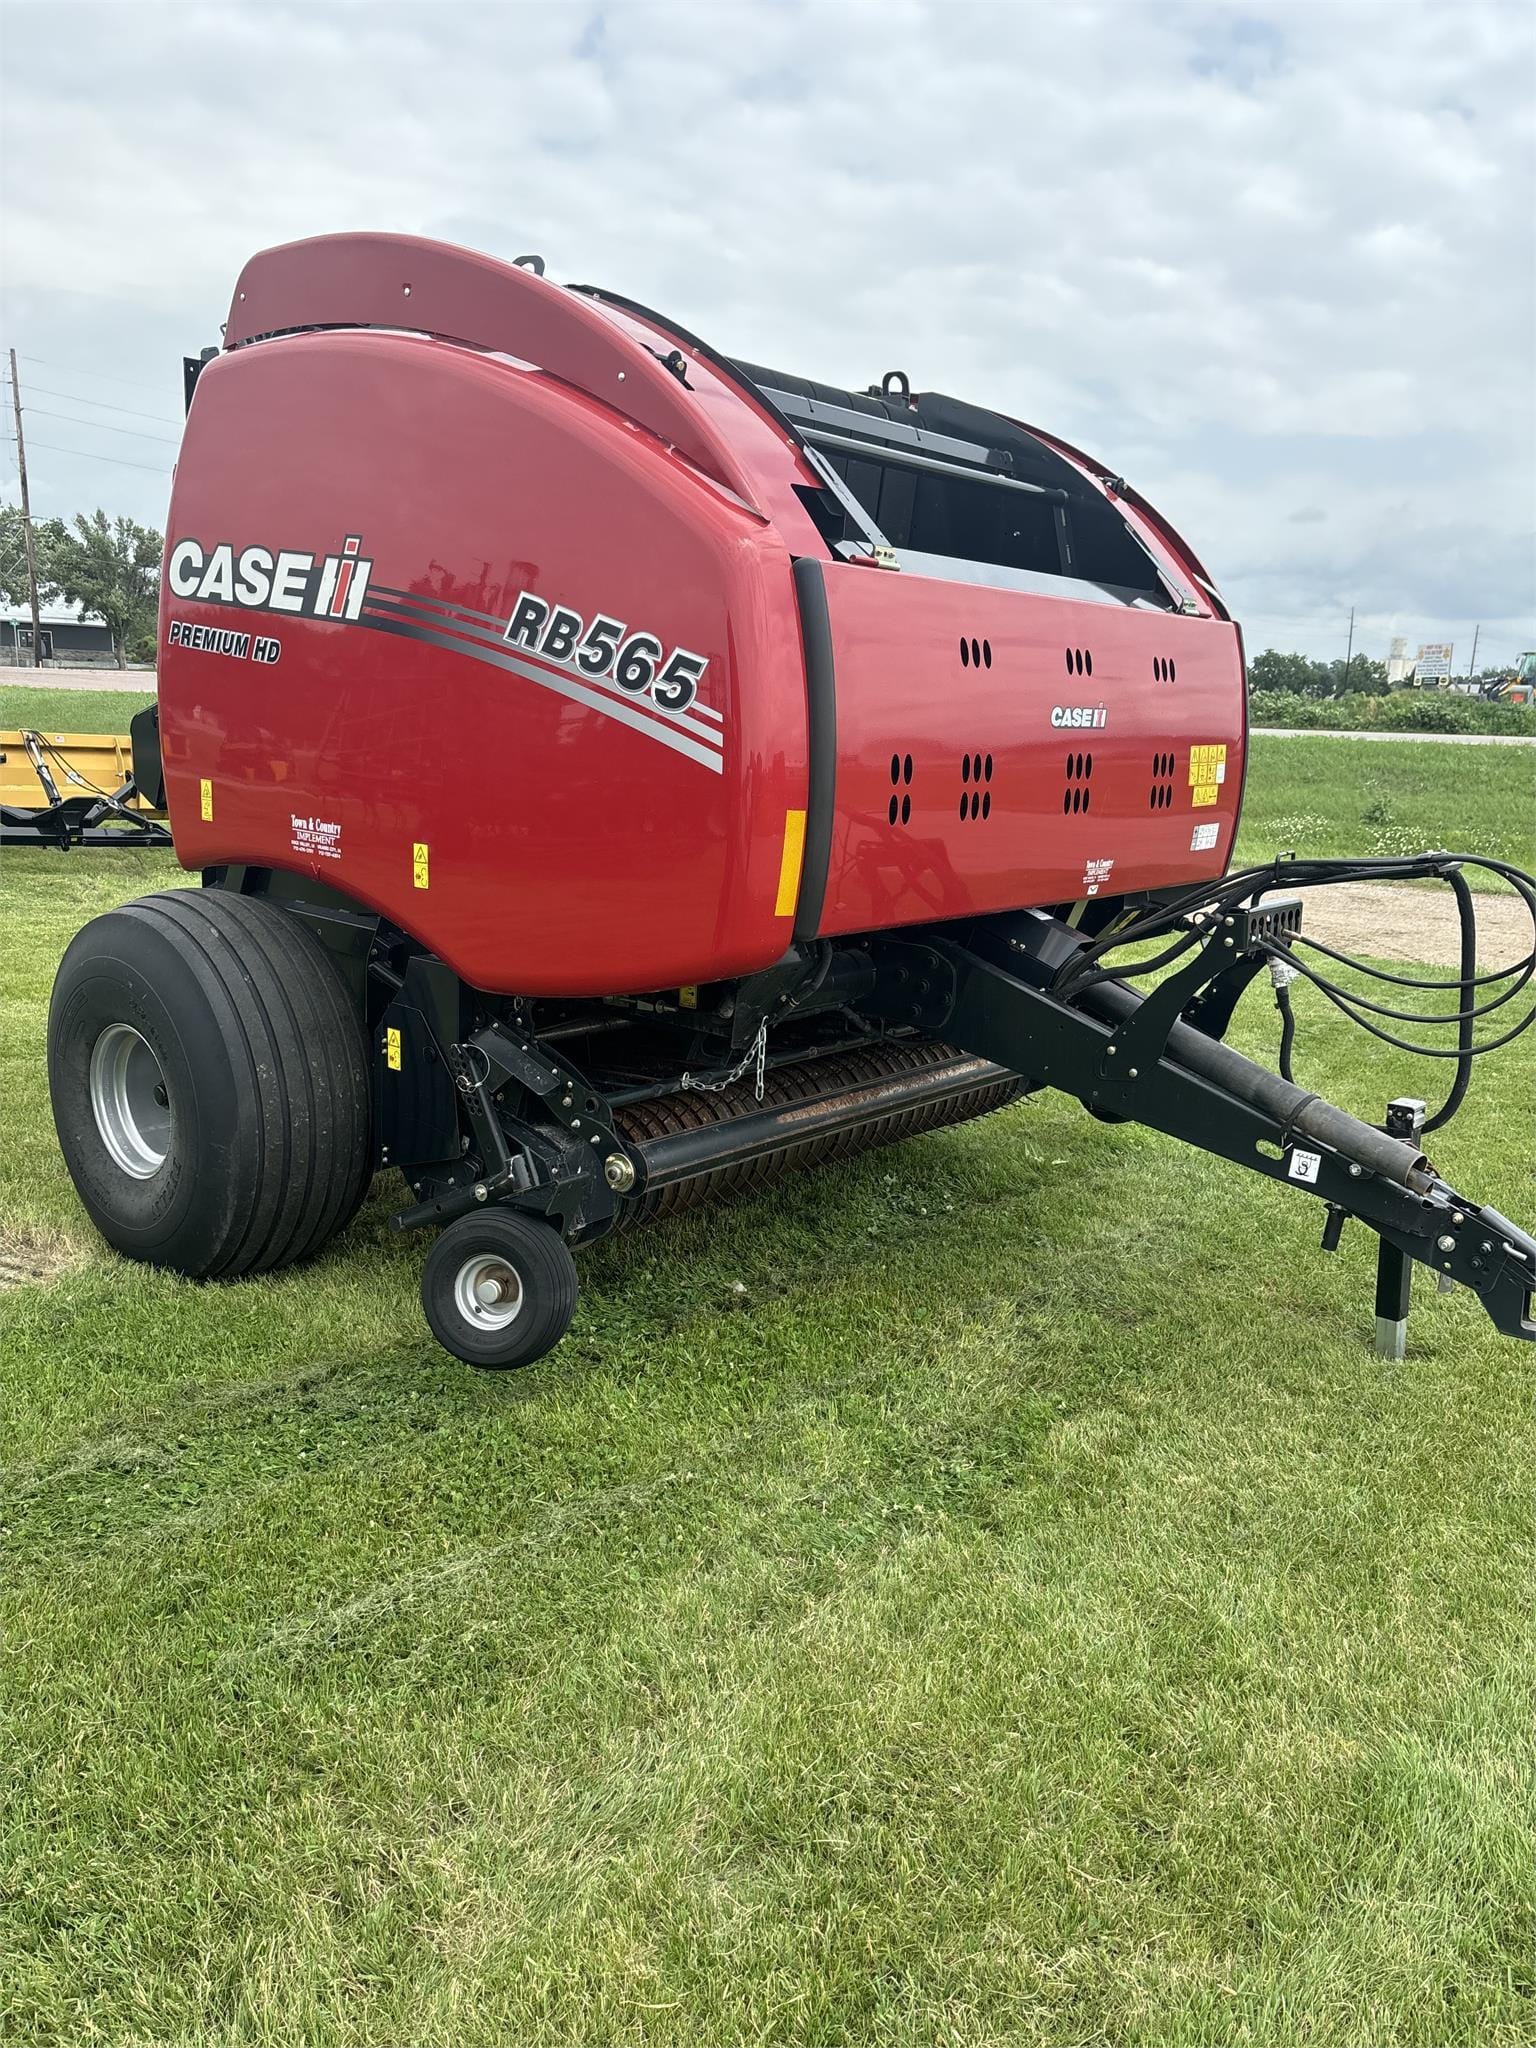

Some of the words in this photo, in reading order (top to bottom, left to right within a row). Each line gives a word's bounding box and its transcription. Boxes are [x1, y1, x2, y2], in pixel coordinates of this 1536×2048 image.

[169, 540, 314, 611] CASE
[168, 621, 250, 659] PREMIUM
[252, 635, 281, 665] HD
[503, 590, 709, 714] RB565
[1051, 706, 1093, 728] CASE
[291, 814, 307, 829] Town
[308, 817, 314, 830] &
[315, 818, 341, 838] Country
[297, 831, 336, 846] IMPLEMENT
